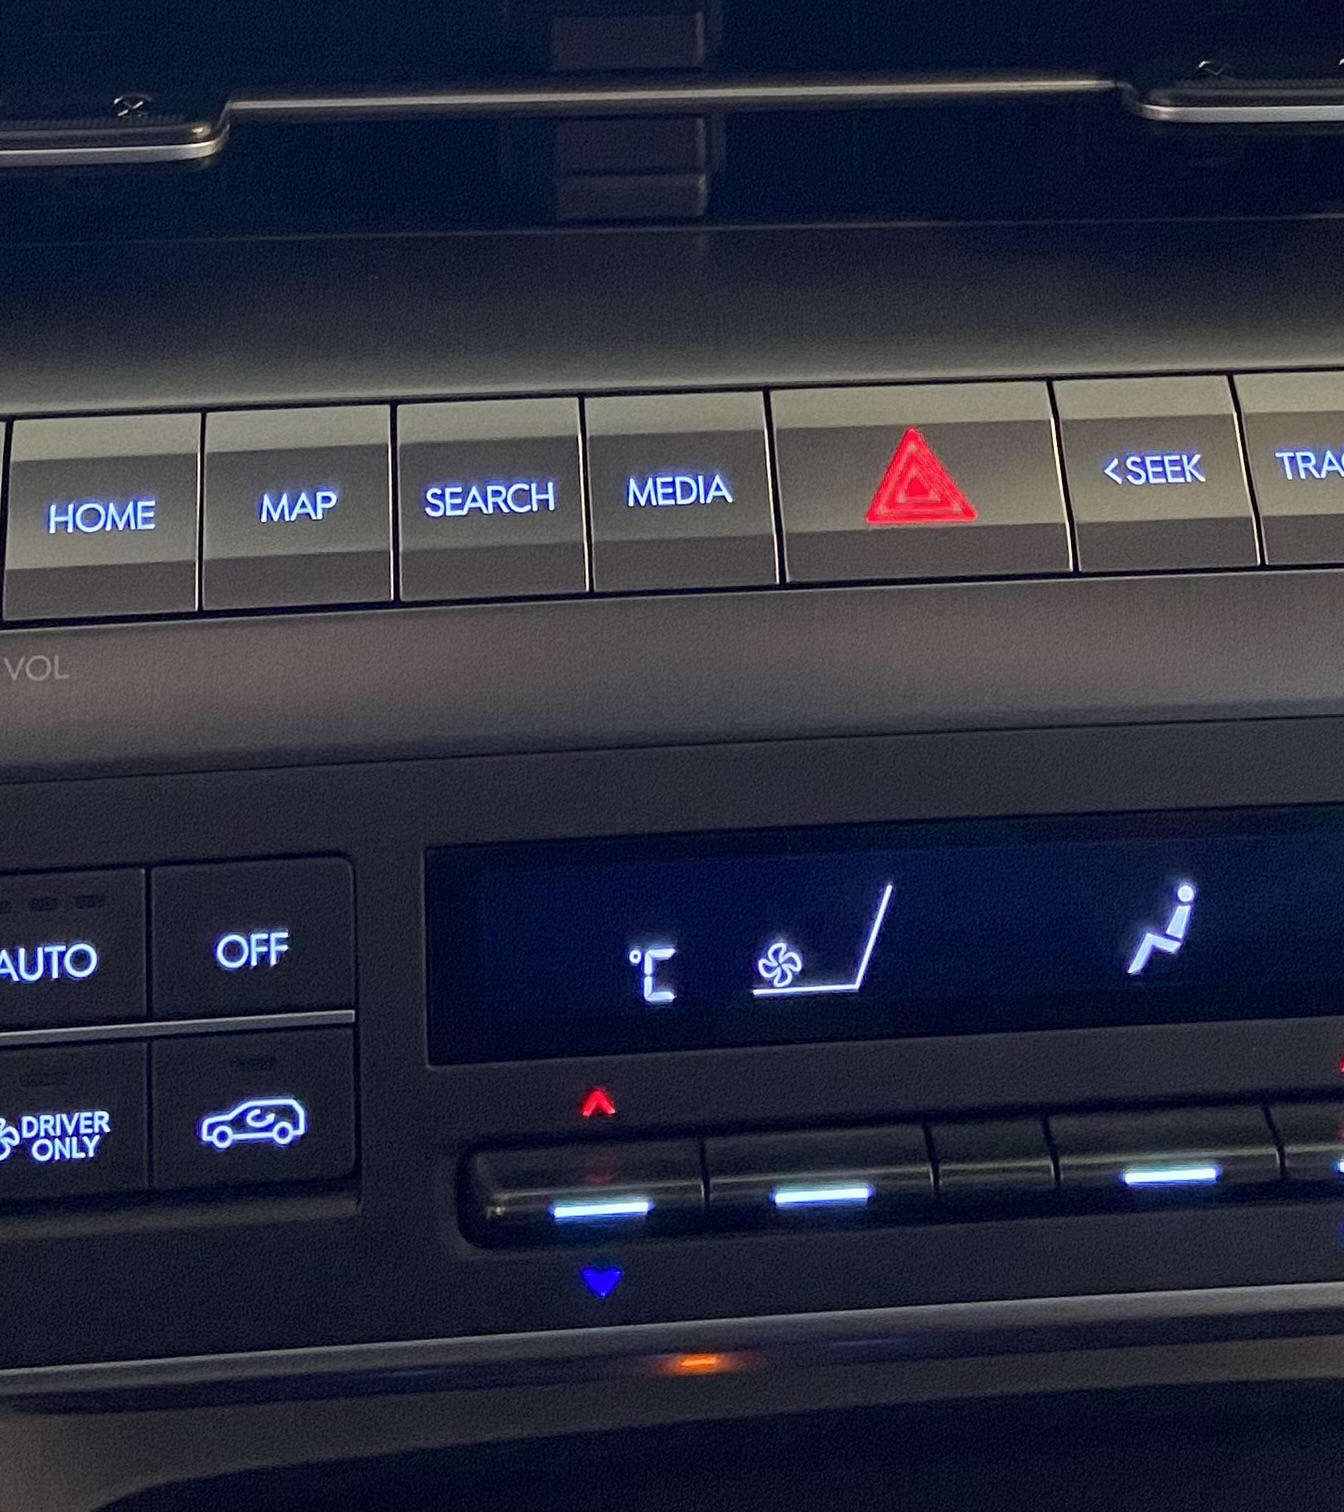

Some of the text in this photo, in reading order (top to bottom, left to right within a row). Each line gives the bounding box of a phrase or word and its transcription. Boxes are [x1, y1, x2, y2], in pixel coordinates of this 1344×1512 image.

[260, 487, 339, 523] MAP
[424, 479, 557, 518] SEARCH
[626, 471, 734, 507] MEDIA
[48, 496, 156, 534] HOME
[213, 929, 289, 971] OFF
[21, 1110, 111, 1139] DRIVER
[31, 1134, 100, 1163] ONLY
